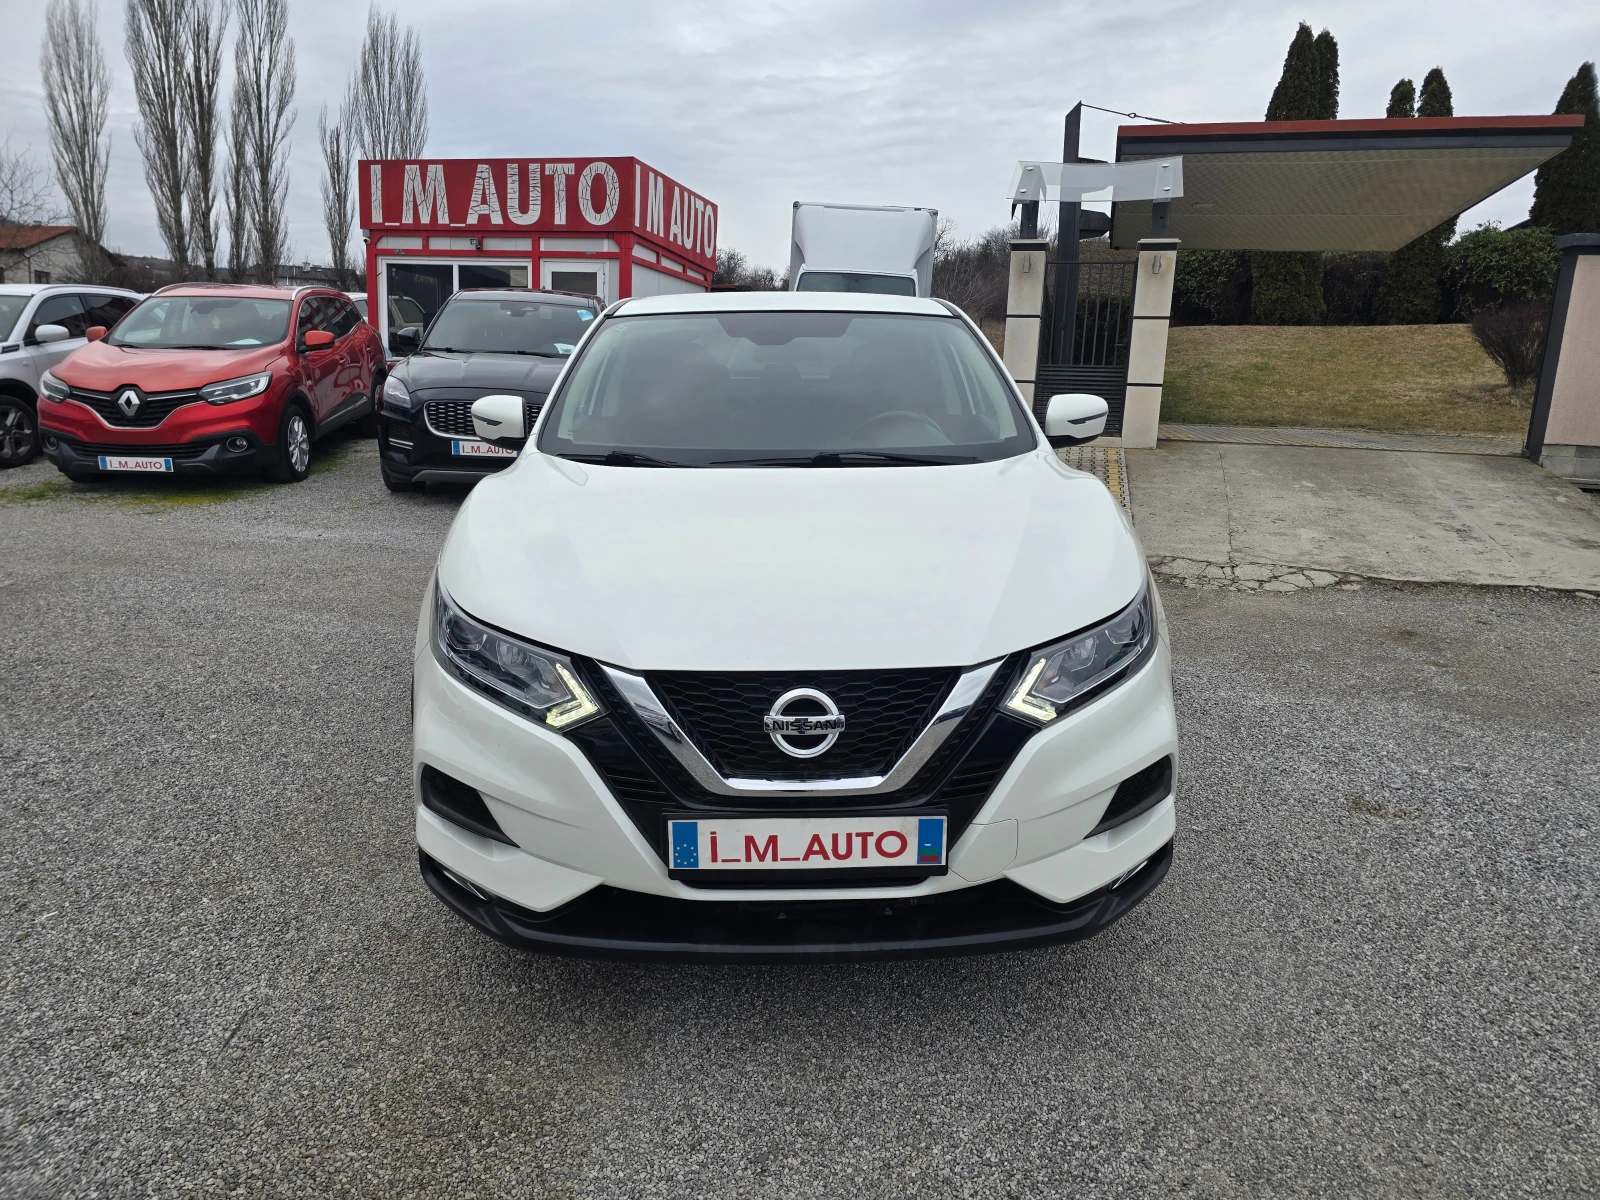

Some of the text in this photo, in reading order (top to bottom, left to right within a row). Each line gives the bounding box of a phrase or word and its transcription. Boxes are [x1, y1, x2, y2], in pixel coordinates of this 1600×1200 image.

[634, 163, 715, 259] I M AUTO
[772, 719, 838, 731] NISSAN
